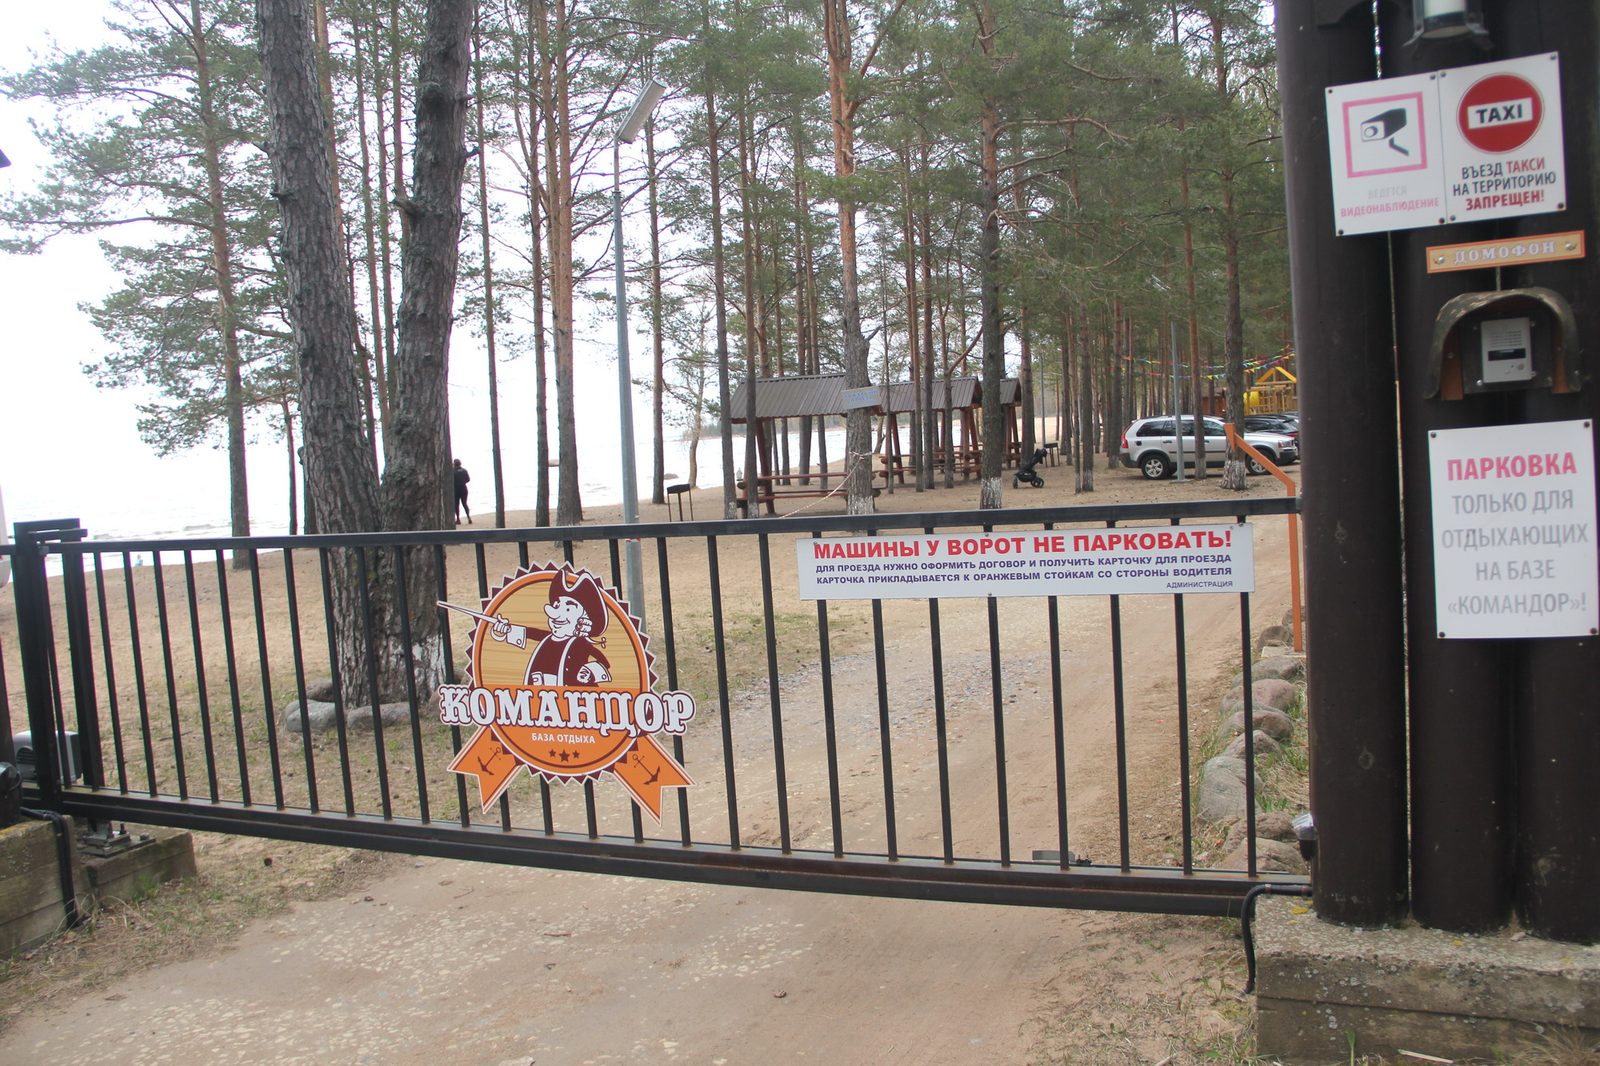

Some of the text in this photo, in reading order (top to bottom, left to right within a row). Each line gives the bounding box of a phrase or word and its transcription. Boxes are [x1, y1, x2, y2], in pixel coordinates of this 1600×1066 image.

[1476, 103, 1523, 124] TAXI
[1462, 157, 1545, 180] ВЪЕЗД ТАКСИ
[1453, 171, 1556, 196] НА ТЕРРИТОРИЮ
[1340, 197, 1440, 218] ВИДЕОНАБЛЮДЕНИЕ
[1466, 190, 1545, 211] ЗАПРЕЩЕН!
[1454, 240, 1556, 265] ДОМОФОН
[1447, 452, 1577, 481] ПАРКОВКА
[1452, 489, 1573, 515] ТОЛЬКО ДЛЯ
[814, 530, 1232, 559] МАШИНЫ У ВОРОТ НЕ ПАРКОВАТЬ!
[1441, 523, 1589, 551] ОТДЫХАЮЩИХ
[816, 554, 1232, 573] ДЛЯ ПРОЕЗДА НУЖНО ОФОРМИТЬ ДОГОВОР И ПОЛУЧИТЬ КАРТОЧКУ ДЛЯ ПРОЕЗДА
[1475, 559, 1555, 581] НА БАЗЕ
[816, 576, 865, 584] КАРТОЧКА
[868, 574, 960, 583] ПРИКЛАДЫВАЕТСЯ
[973, 572, 1041, 581] ОРАНЖЕВЫМ
[1044, 570, 1094, 579] СТОЙКАМ
[1097, 570, 1112, 578] СО
[1116, 569, 1169, 578] СТОРОНЫ
[1173, 567, 1232, 577] ВОДИТЕЛЯ
[1166, 580, 1233, 589] АДМИНИСТРАЦИЯ
[1447, 592, 1587, 617] «КОМАНДОР»!
[531, 732, 596, 744] БАЗА ОТДЫХА
